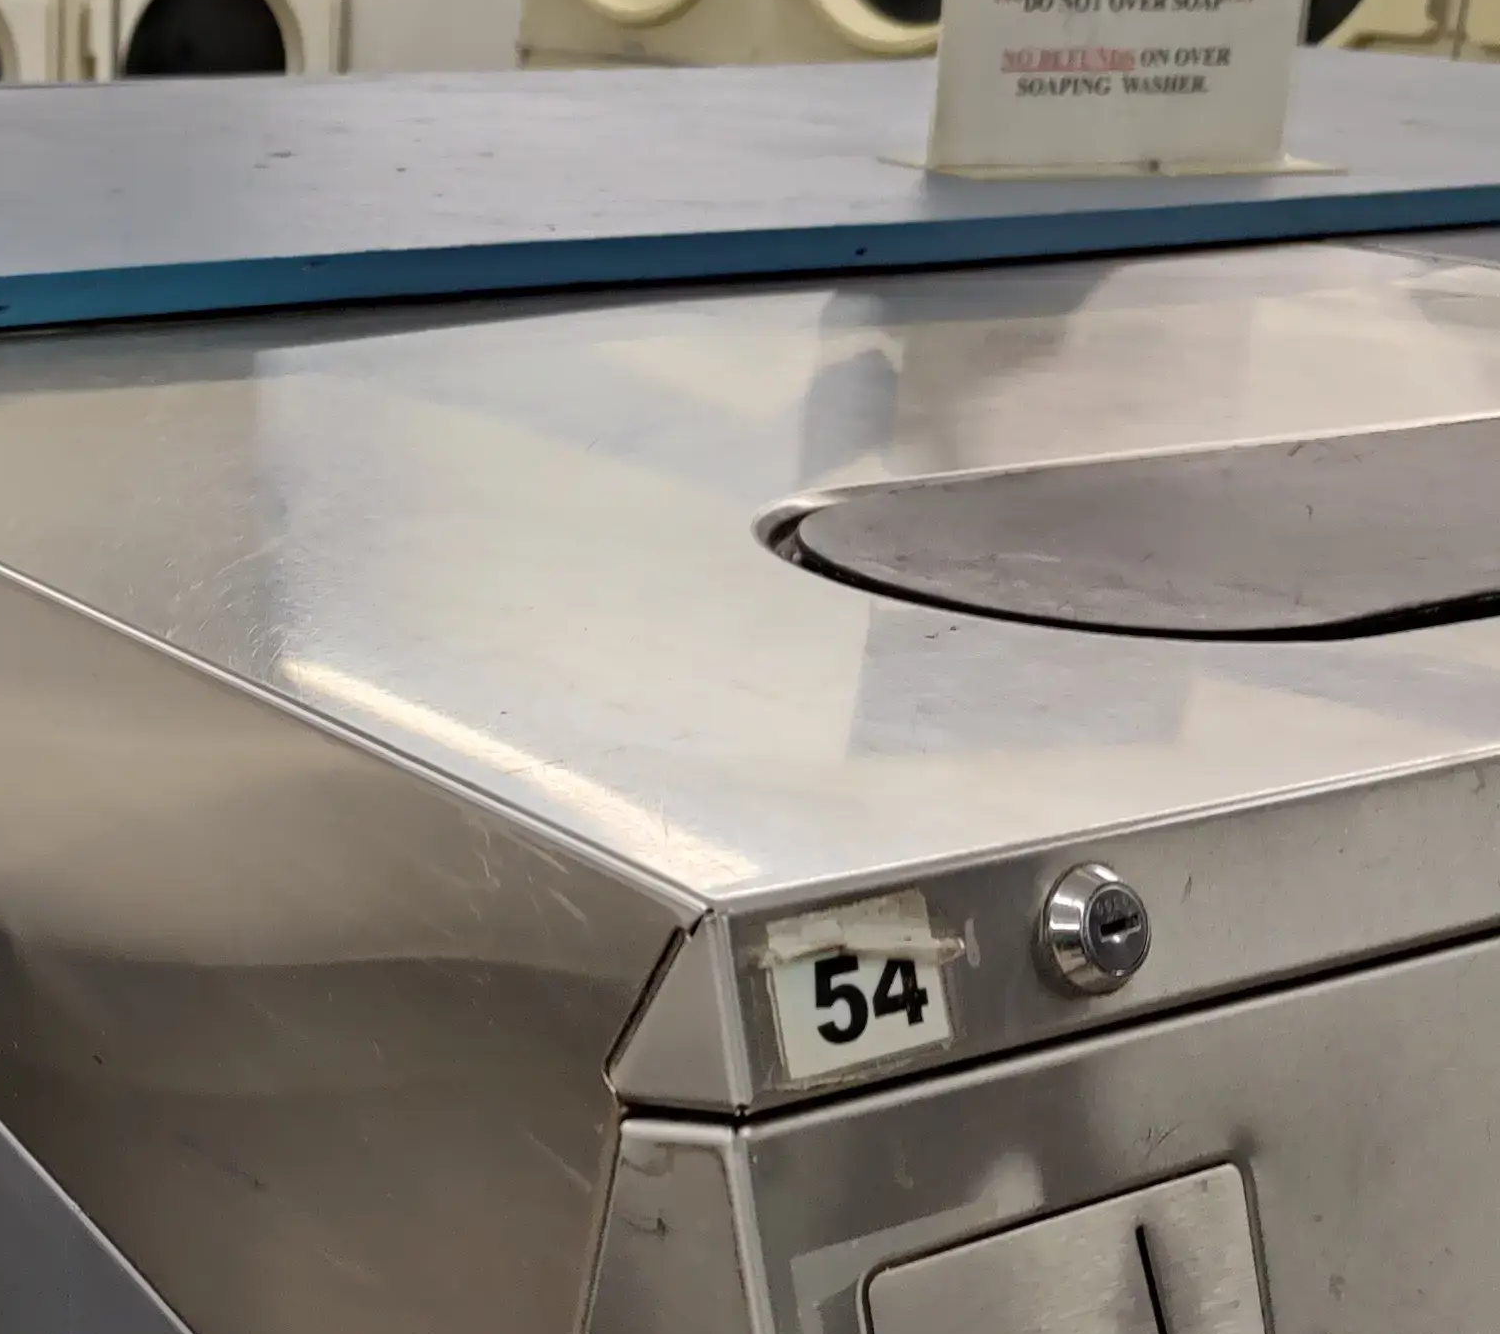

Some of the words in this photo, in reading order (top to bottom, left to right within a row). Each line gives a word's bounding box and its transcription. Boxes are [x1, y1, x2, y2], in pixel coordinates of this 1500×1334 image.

[1140, 47, 1170, 67] ON
[1174, 46, 1231, 67] OVER
[1016, 75, 1112, 97] SOAPING
[813, 954, 929, 1045] 54
